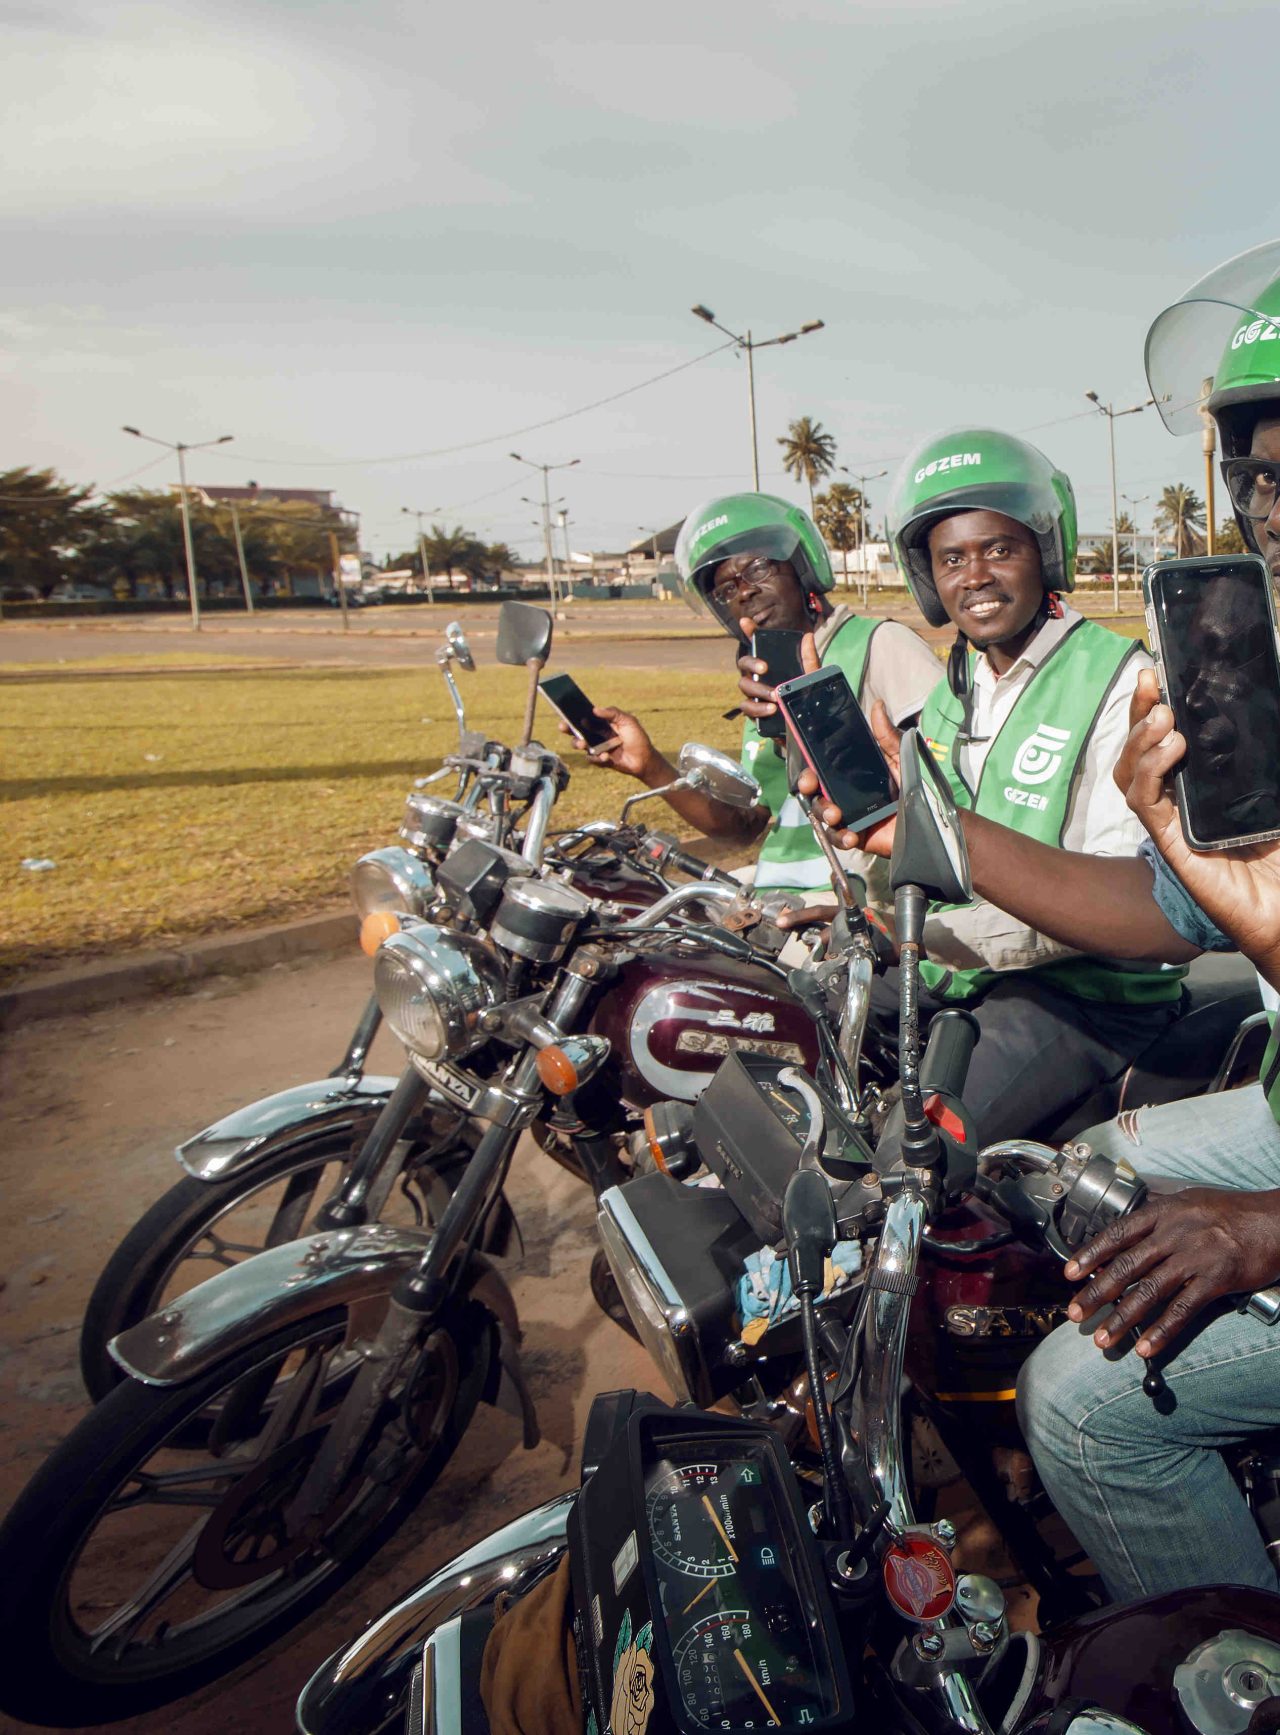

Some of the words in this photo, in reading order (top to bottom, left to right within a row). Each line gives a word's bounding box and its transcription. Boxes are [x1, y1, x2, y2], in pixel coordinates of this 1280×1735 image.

[914, 453, 981, 483] GOZEM
[670, 1486, 678, 1494] 10
[683, 1479, 691, 1487] 11
[696, 1476, 704, 1484] 12
[709, 1476, 718, 1485] 13
[670, 1503, 681, 1541] SANYA
[721, 1625, 731, 1640] 160
[742, 1624, 752, 1639] 180
[704, 1632, 714, 1648] 140
[688, 1649, 698, 1665] 120
[682, 1669, 692, 1685] 100
[758, 1659, 771, 1686] km/h
[687, 1693, 696, 1705] 80
[700, 1708, 710, 1721] 60
